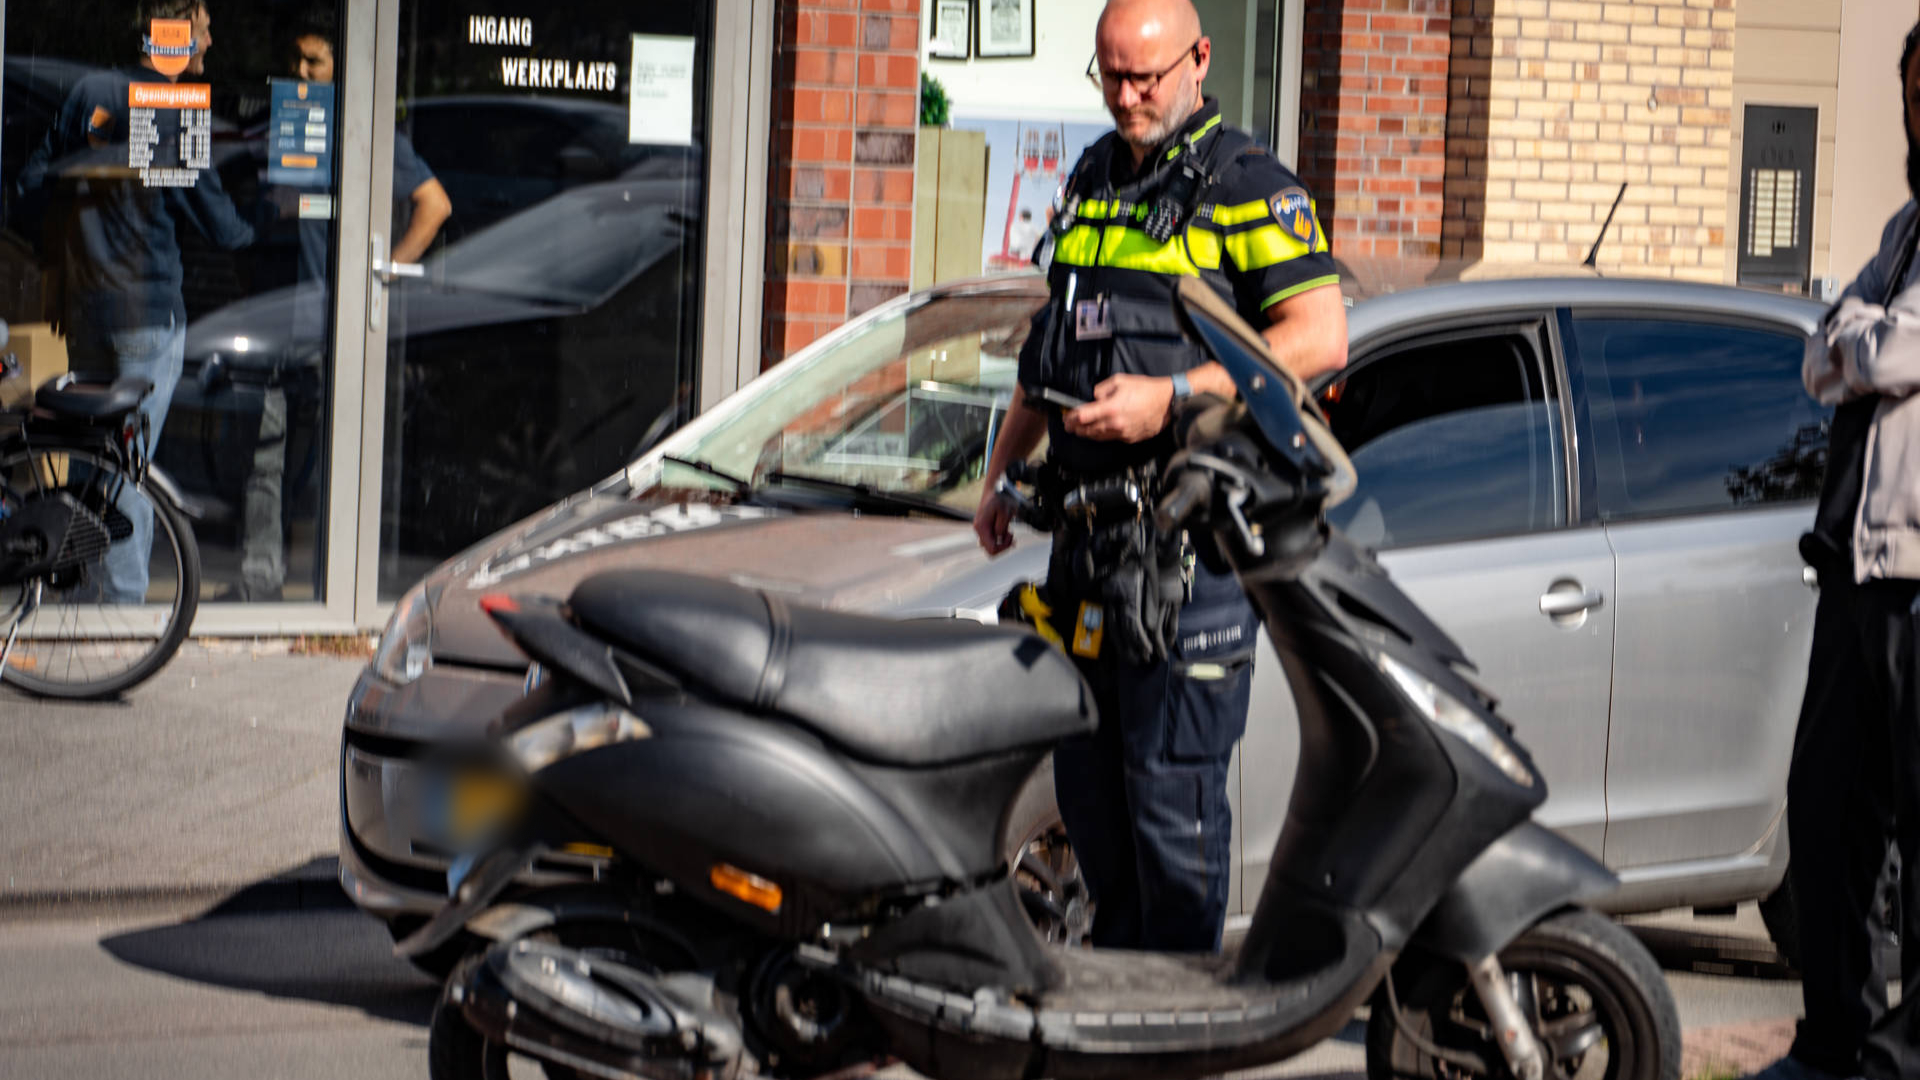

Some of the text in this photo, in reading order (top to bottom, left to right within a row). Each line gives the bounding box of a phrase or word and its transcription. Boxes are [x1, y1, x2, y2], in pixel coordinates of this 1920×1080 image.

[469, 15, 532, 46] INGANG
[502, 56, 616, 91] WERKPLAATS
[135, 86, 206, 105] Openingstijden
